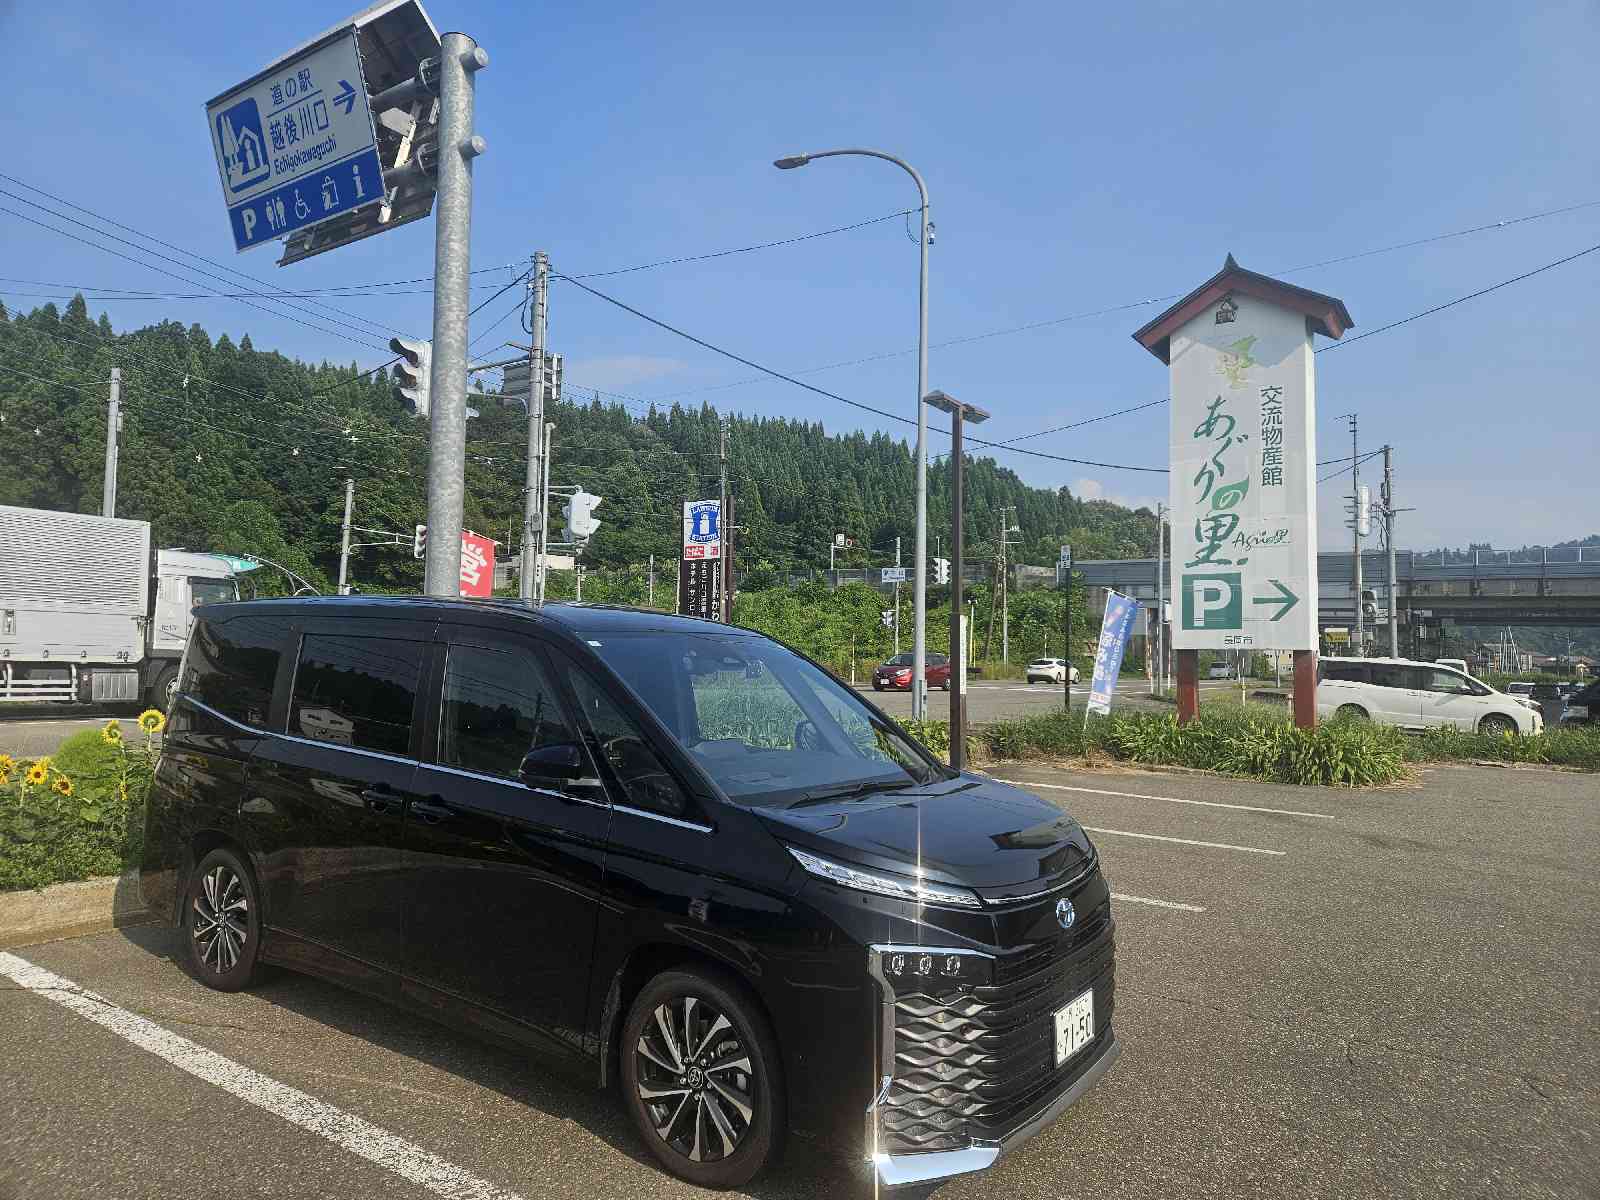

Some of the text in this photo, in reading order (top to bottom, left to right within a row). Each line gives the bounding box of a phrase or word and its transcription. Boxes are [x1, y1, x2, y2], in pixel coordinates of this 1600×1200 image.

[269, 67, 314, 105] 道の駅
[269, 99, 330, 153] 越後川口
[273, 134, 337, 176] Echigokawaguchi
[1260, 384, 1284, 487] 交流物産館
[1185, 394, 1249, 569] あぐりの里
[1194, 580, 1232, 627] P
